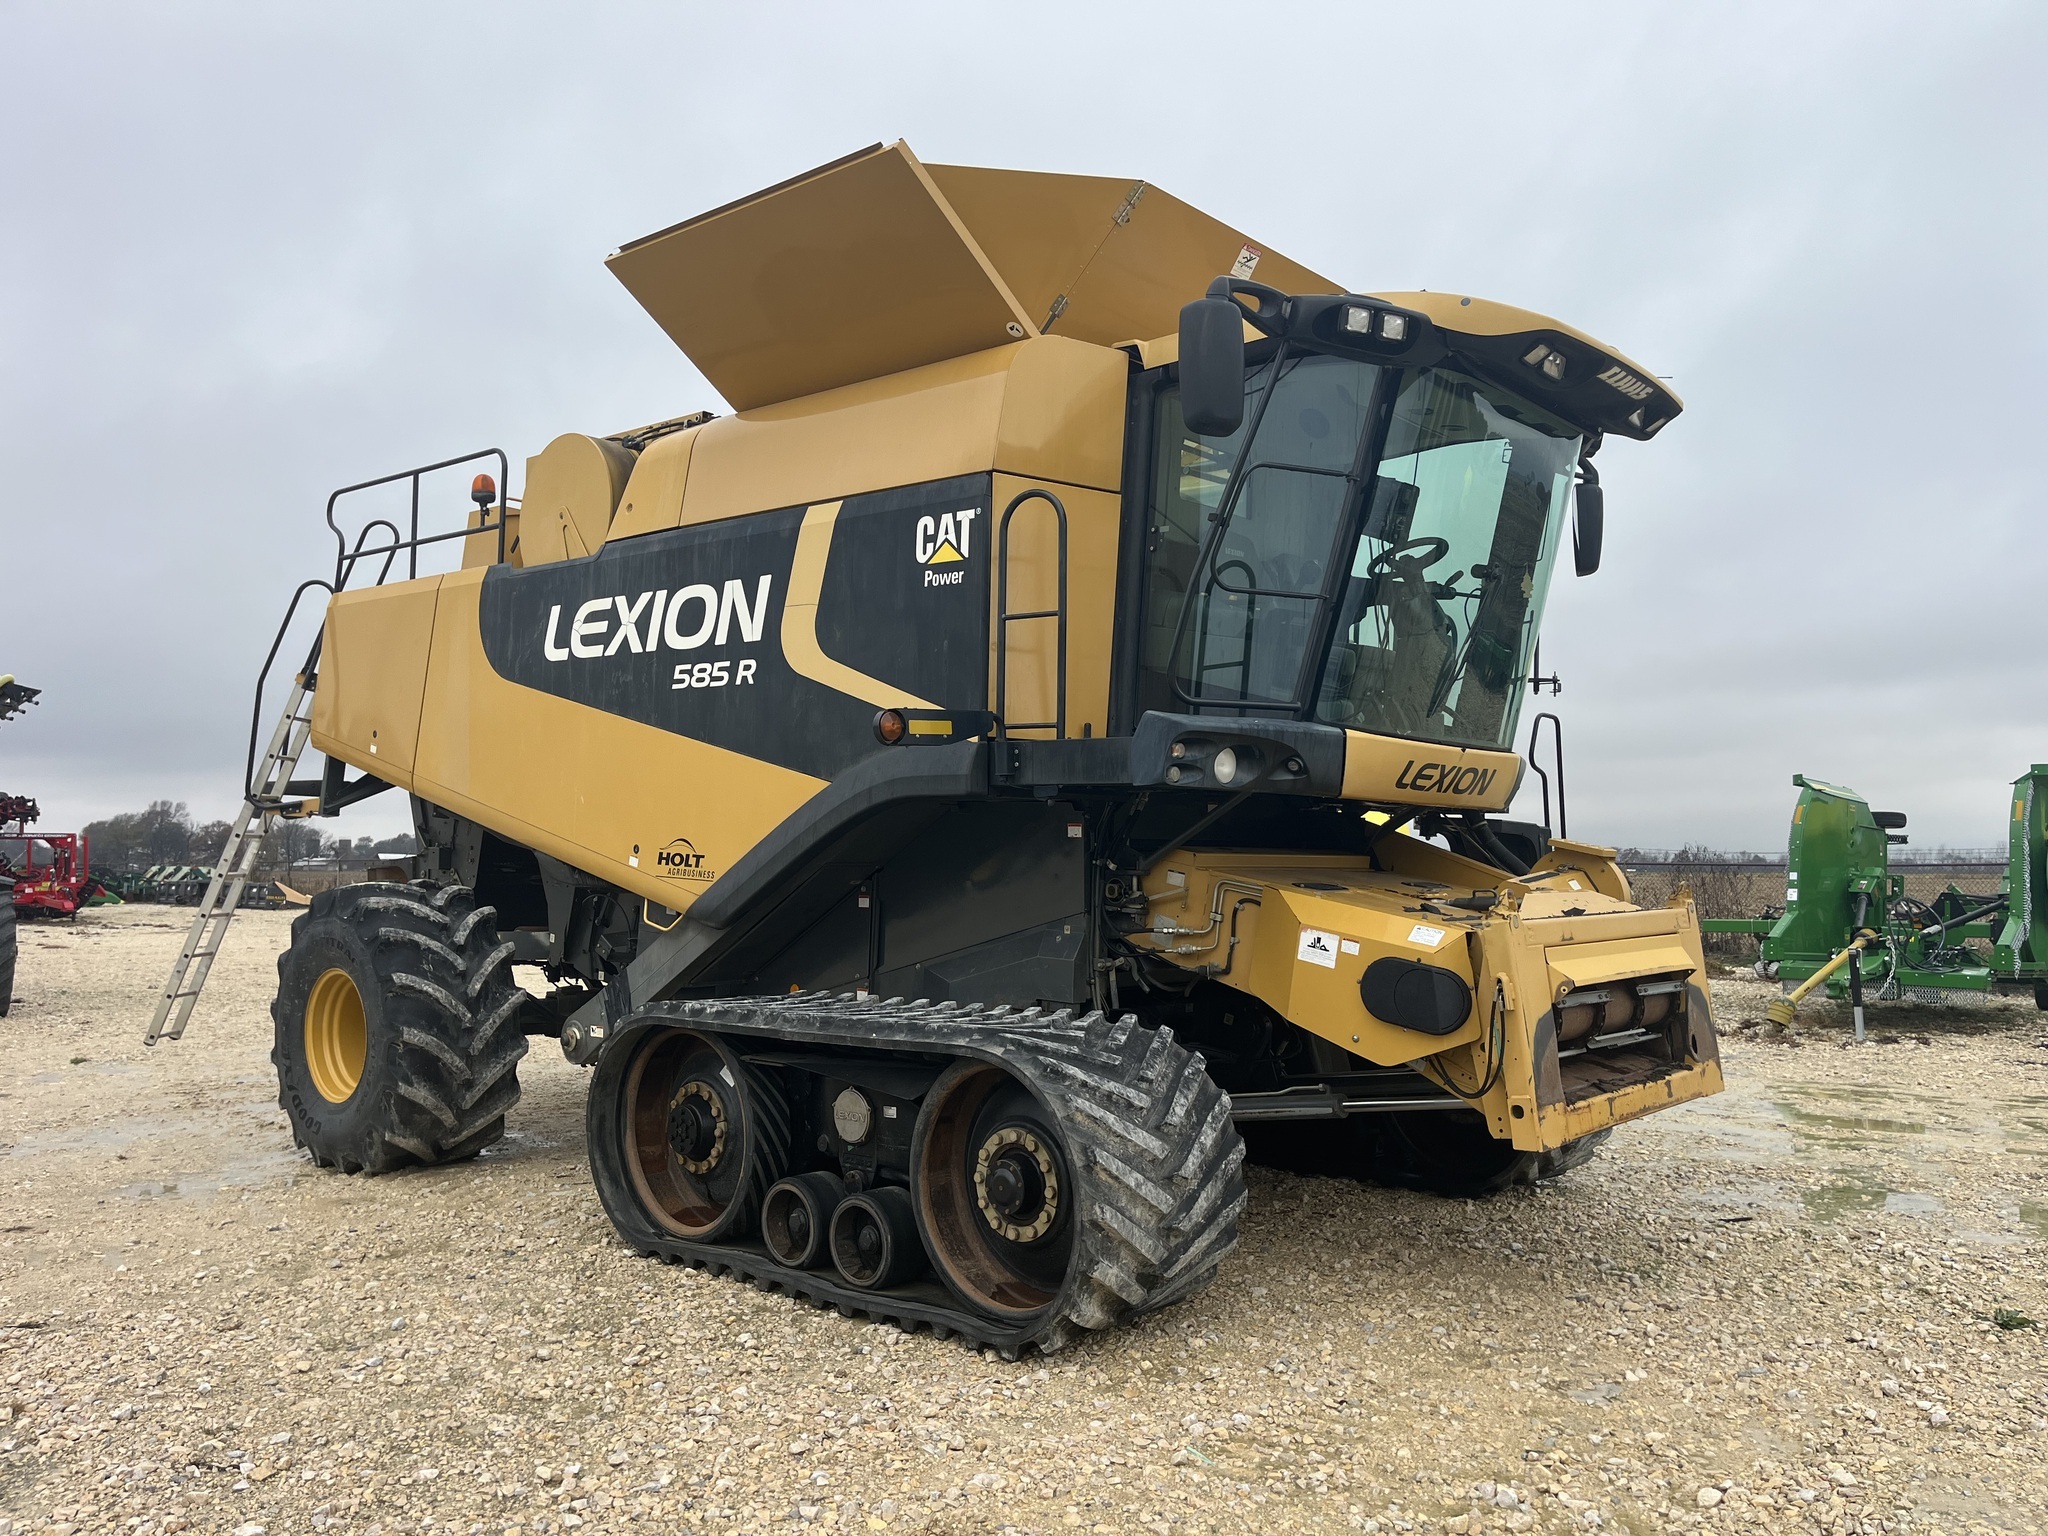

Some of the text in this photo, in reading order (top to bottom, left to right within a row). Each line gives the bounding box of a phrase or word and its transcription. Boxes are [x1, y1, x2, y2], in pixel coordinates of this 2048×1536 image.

[924, 570, 964, 587] Power
[544, 574, 772, 662] LEXION
[671, 658, 757, 689] 585 R
[1395, 760, 1497, 796] LEXION
[657, 851, 705, 868] HOLT
[667, 867, 715, 879] AGRIBUSINESS
